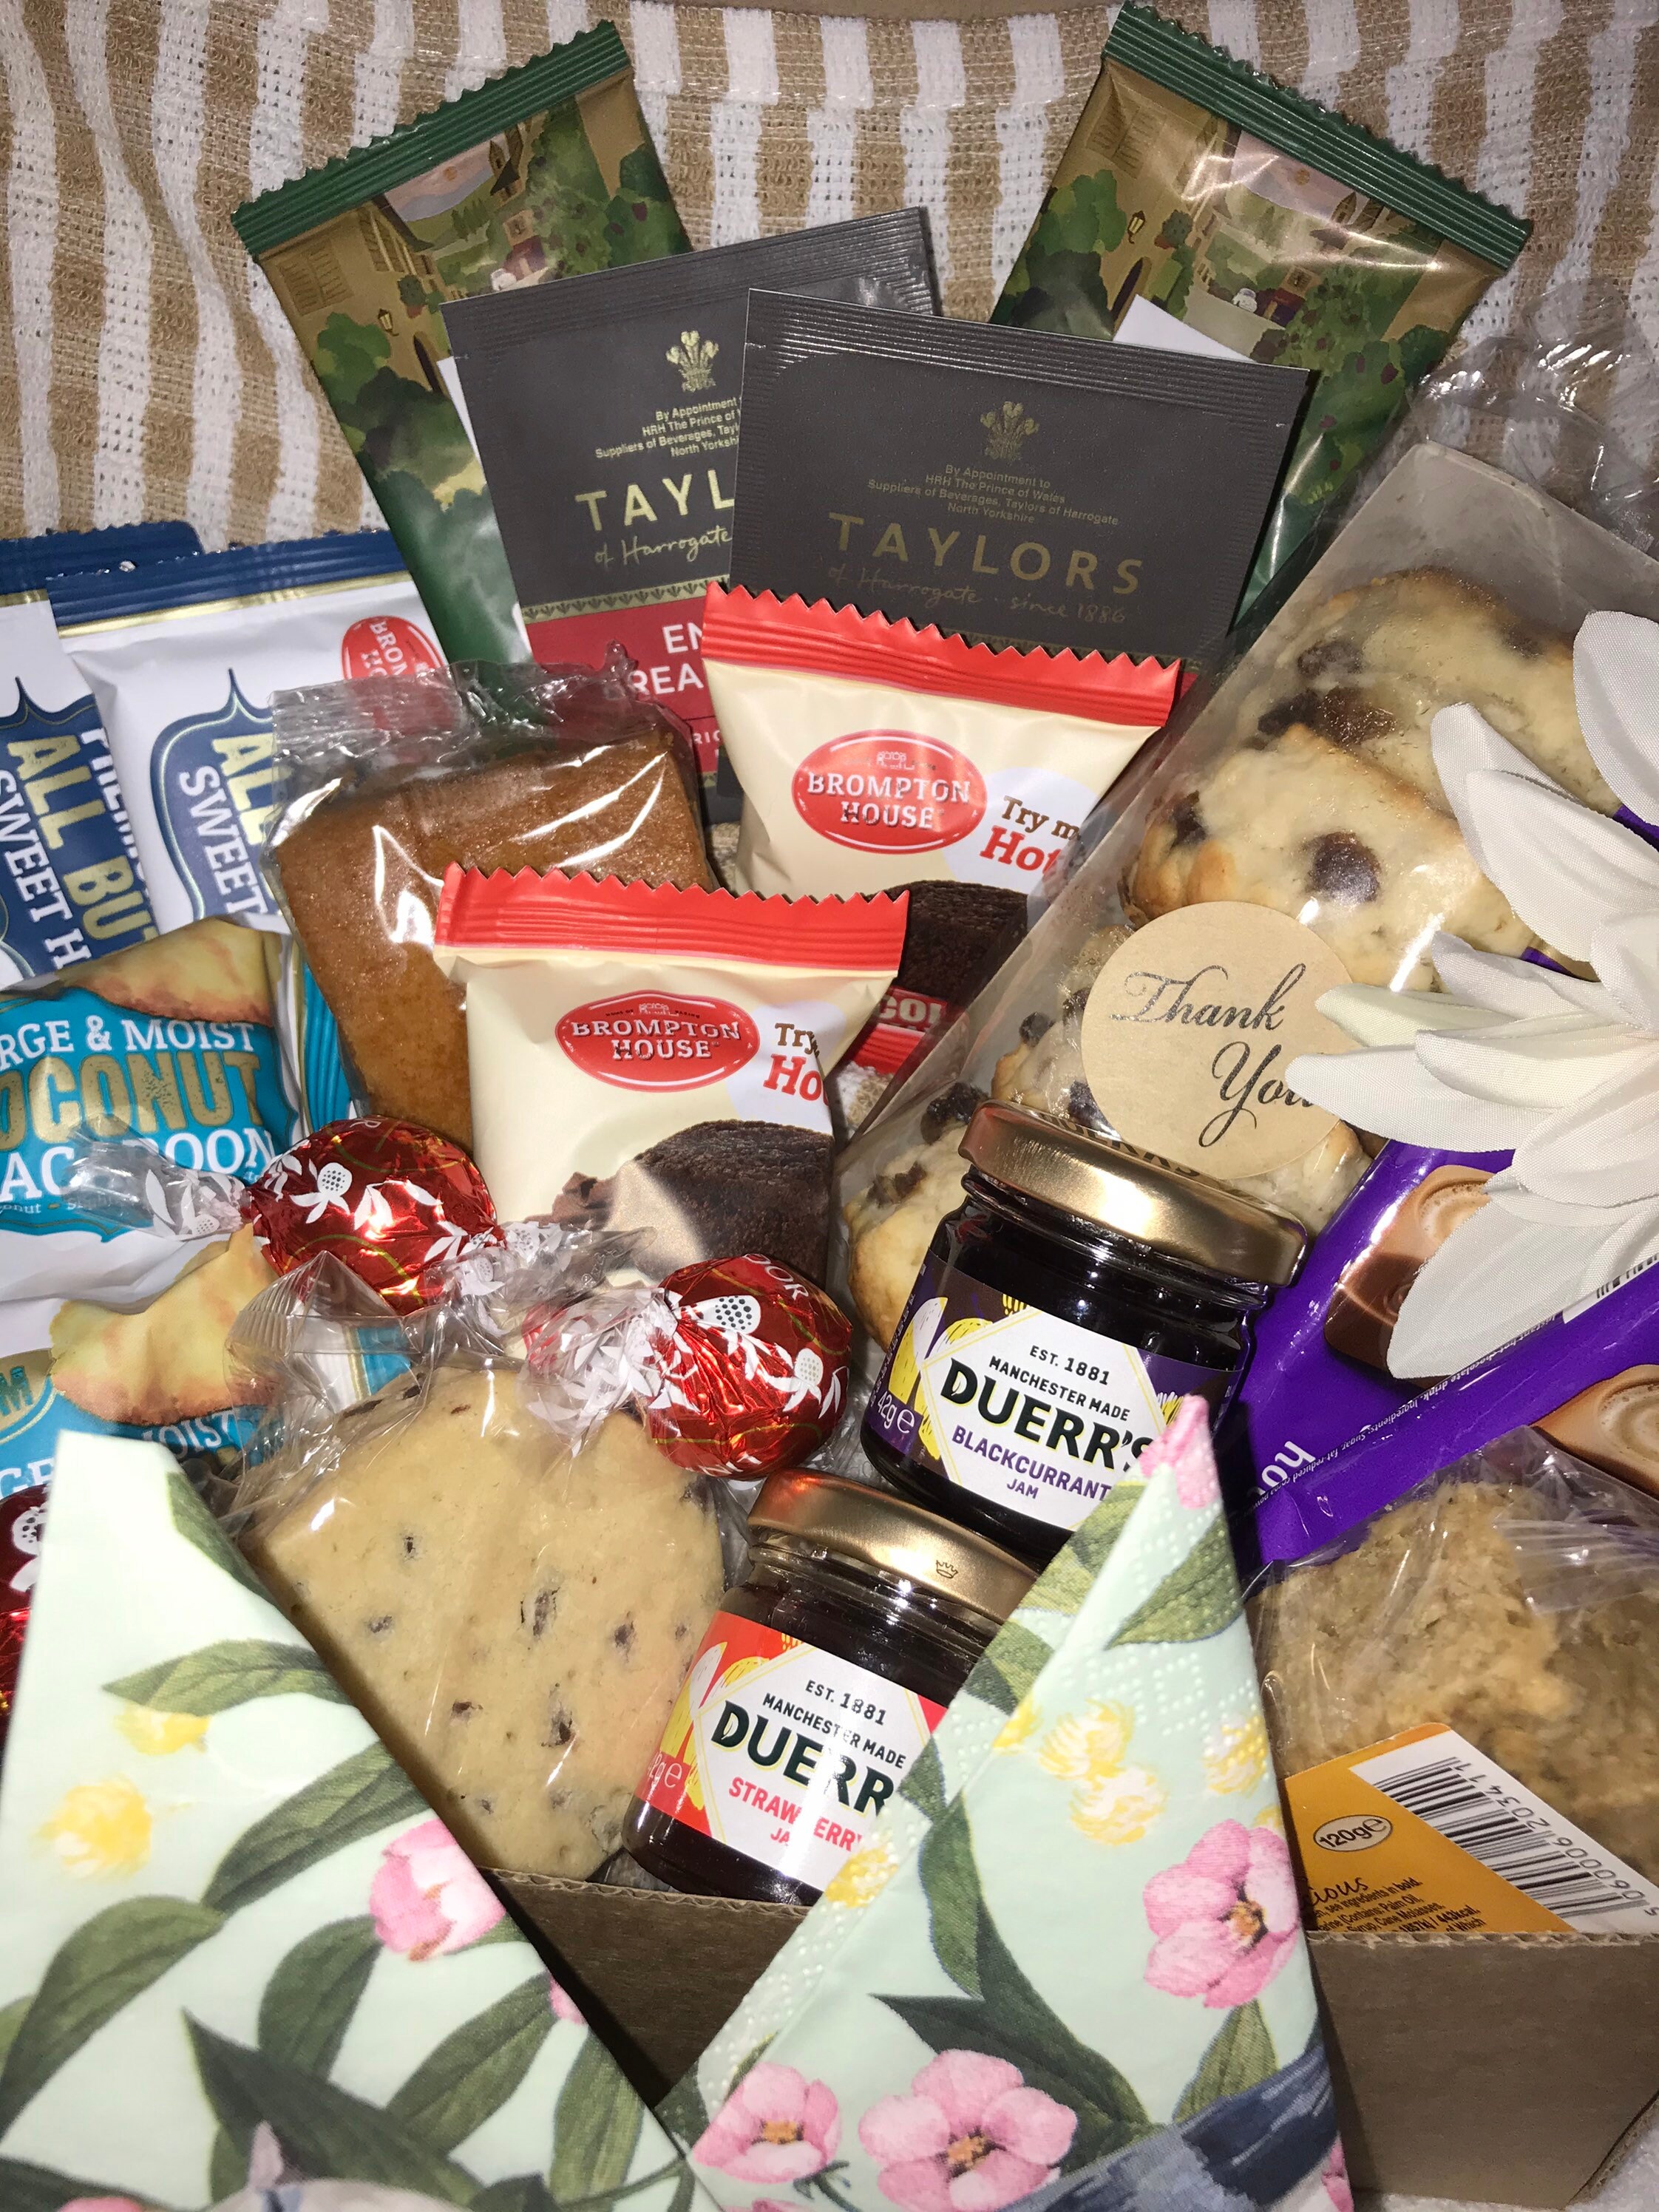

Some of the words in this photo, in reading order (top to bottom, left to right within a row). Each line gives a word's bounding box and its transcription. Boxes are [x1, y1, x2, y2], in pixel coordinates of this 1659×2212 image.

[642, 422, 666, 437] HRH
[668, 419, 688, 432] The
[690, 413, 722, 427] Prince
[725, 410, 736, 421] of
[656, 410, 669, 422] By
[672, 396, 737, 419] Appointment
[595, 441, 644, 458] Suppliers
[645, 438, 657, 449] of
[670, 444, 699, 458] North
[926, 474, 951, 486] HRH
[955, 478, 976, 490] The
[979, 481, 1014, 495] Prince
[1017, 489, 1029, 498] of
[1033, 489, 1065, 503] Wales
[946, 464, 960, 476] By
[963, 467, 1036, 487] Appointment
[1039, 479, 1051, 489] to
[576, 469, 735, 531] TAYL
[867, 478, 921, 495] Suppliers
[924, 487, 936, 497] of
[1005, 498, 1045, 513] Taylors
[1048, 506, 1061, 516] of
[1063, 508, 1119, 526] Harrogate
[947, 501, 978, 515] North
[983, 506, 1035, 524] Yorkshire
[594, 548, 614, 565] of
[622, 525, 733, 565] Harrogate
[829, 512, 1143, 594] TAYLORS
[828, 563, 848, 588] of
[857, 567, 982, 608] Harrogate
[1010, 593, 1068, 617] since
[1078, 603, 1126, 624] 1886
[7, 735, 106, 850] ALL
[807, 771, 971, 804] BROMPTON
[841, 801, 935, 830] HOUSE
[1001, 795, 1050, 833] Try
[179, 765, 268, 917] SWEET
[1109, 963, 1306, 1031] Thank
[86, 1015, 112, 1051] &
[121, 1018, 255, 1052] MOIST
[571, 1019, 741, 1040] BROMPTON
[775, 1022, 815, 1055] Try
[611, 1039, 711, 1060] HOUSE
[763, 1054, 828, 1106] Ho
[1029, 1344, 1059, 1367] EST.
[1064, 1357, 1110, 1386] 1881
[988, 1355, 1087, 1407] MANCHESTER
[1088, 1397, 1131, 1422] MADE
[142, 1408, 236, 1460] OIST
[951, 1424, 1113, 1502] BLACKCURRANT
[1292, 1448, 1339, 1484] fat-reduced
[1006, 1479, 1039, 1499] JAM
[804, 1679, 835, 1703] EST.
[839, 1692, 886, 1726] 1881
[761, 1692, 861, 1748] MANCHESTER
[862, 1738, 907, 1769] MADE
[728, 1776, 863, 1852] STRAWERR
[1453, 1763, 1550, 1830] 203411
[1310, 1876, 1369, 1907] ious
